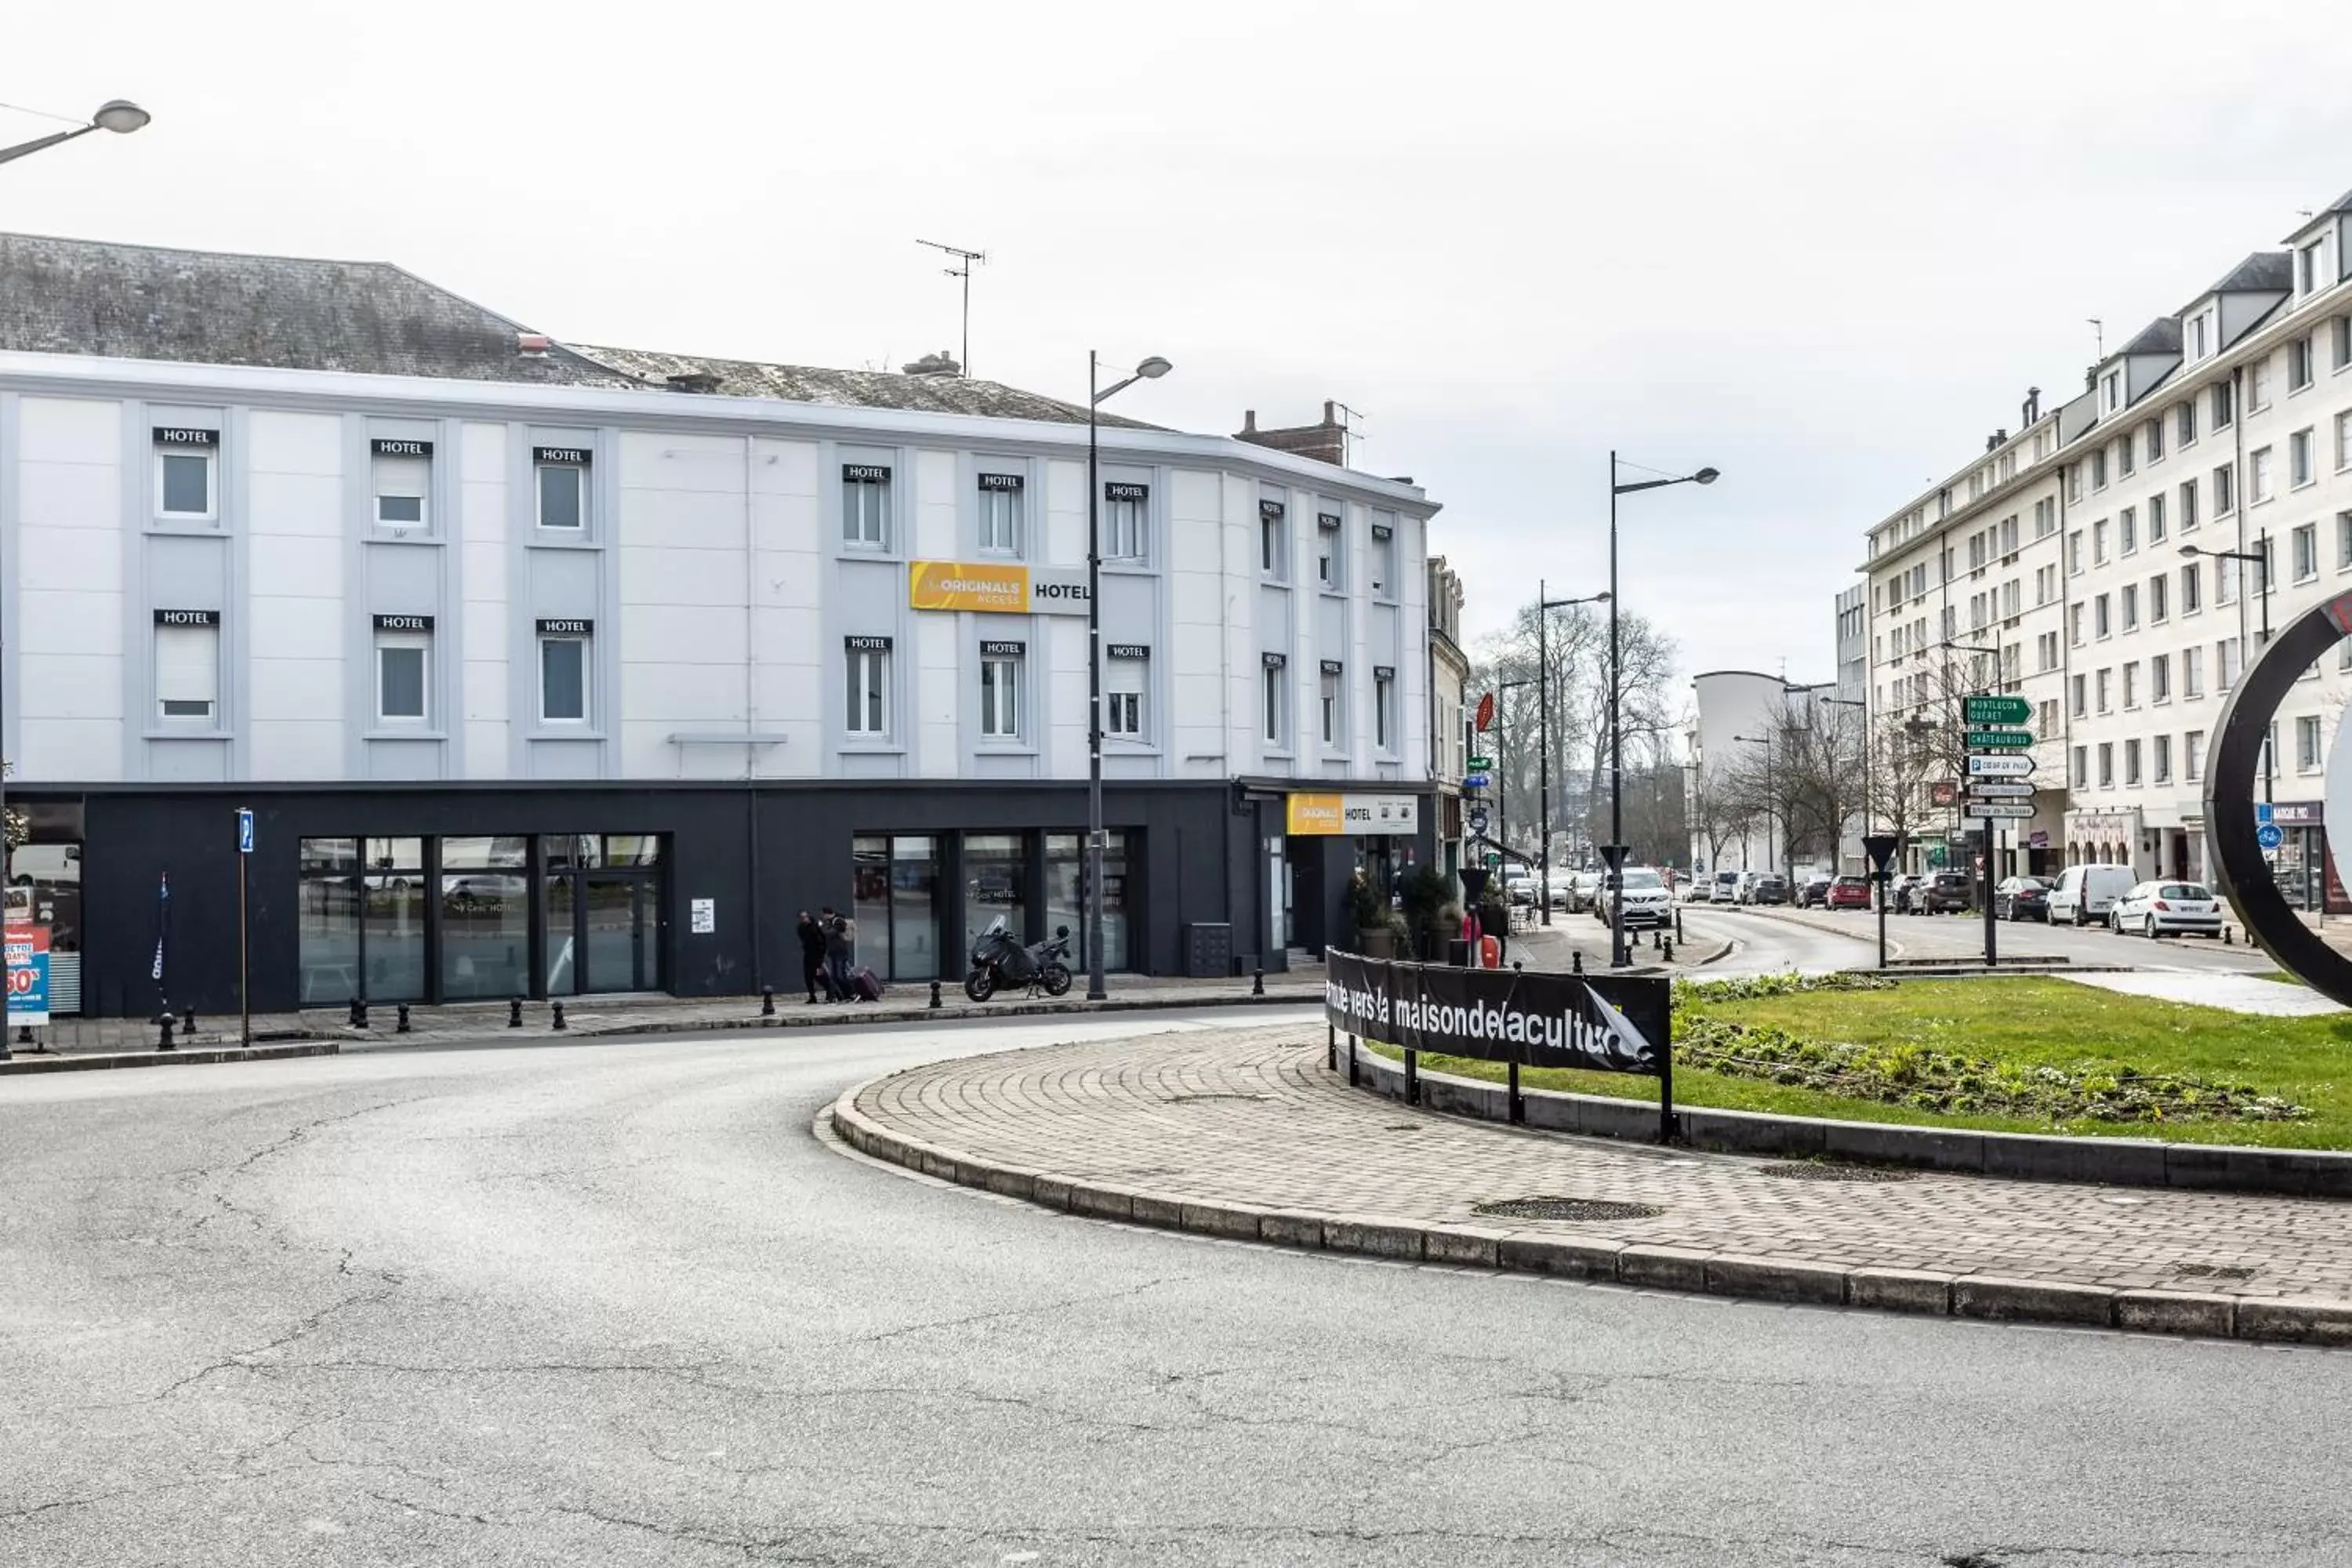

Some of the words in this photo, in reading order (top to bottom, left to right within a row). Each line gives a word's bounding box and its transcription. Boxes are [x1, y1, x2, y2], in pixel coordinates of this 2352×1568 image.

[163, 429, 209, 444] HOTEL
[380, 441, 425, 455] HOTEL
[542, 448, 585, 463] HOTEL
[849, 466, 885, 479] HOTEL
[985, 475, 1019, 488] HOTEL
[1112, 485, 1145, 497] HOTEL
[941, 579, 1020, 594] ORIGINALS
[1036, 583, 1091, 600] HOTEL
[164, 611, 210, 626] HOTEL
[383, 615, 427, 630] HOTEL
[545, 619, 586, 633] HOTEL
[852, 637, 887, 649] HOTEL
[986, 642, 1022, 654] HOTEL
[1113, 645, 1145, 656] HOTEL
[1345, 808, 1371, 820] HOTEL
